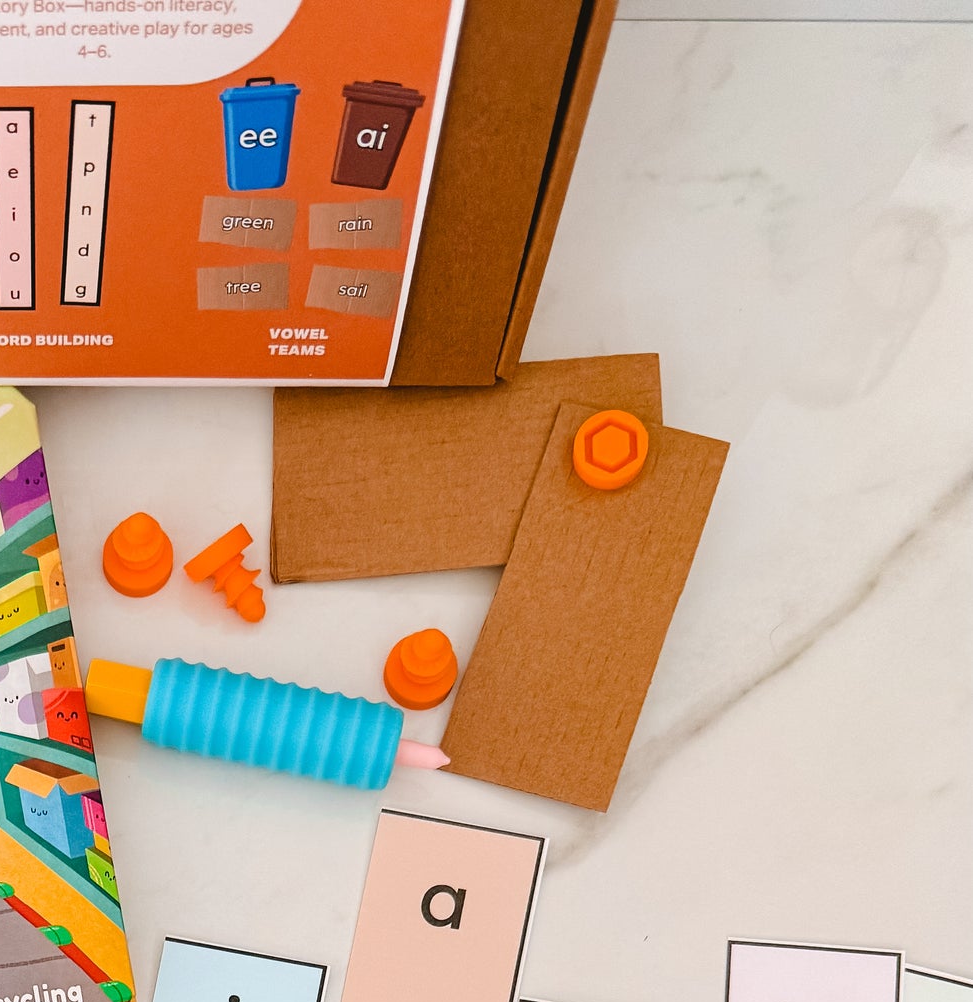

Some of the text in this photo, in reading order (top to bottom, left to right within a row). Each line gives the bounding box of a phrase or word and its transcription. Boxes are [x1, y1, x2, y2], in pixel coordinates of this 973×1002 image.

[169, 0, 237, 15] literacy,
[35, 22, 66, 37] and
[71, 22, 140, 37] creative
[144, 21, 180, 38] play
[184, 20, 208, 35] for
[212, 23, 254, 38] ages
[6, 122, 19, 134] a
[88, 114, 97, 128] t
[239, 127, 278, 149] ee
[356, 123, 389, 150] ai
[7, 167, 19, 179] e
[83, 161, 96, 177] p
[11, 207, 16, 222] i
[81, 205, 92, 216] n
[222, 215, 274, 231] green
[338, 216, 373, 232] rain
[9, 251, 21, 263] o
[77, 243, 90, 257] d
[75, 285, 87, 299] g
[226, 280, 261, 295] tree
[338, 282, 368, 298] sail
[10, 290, 21, 300] u
[35, 335, 114, 346] BUILDING
[269, 328, 329, 340] VOWEL
[268, 344, 325, 356] TEAMS
[420, 884, 467, 930] a
